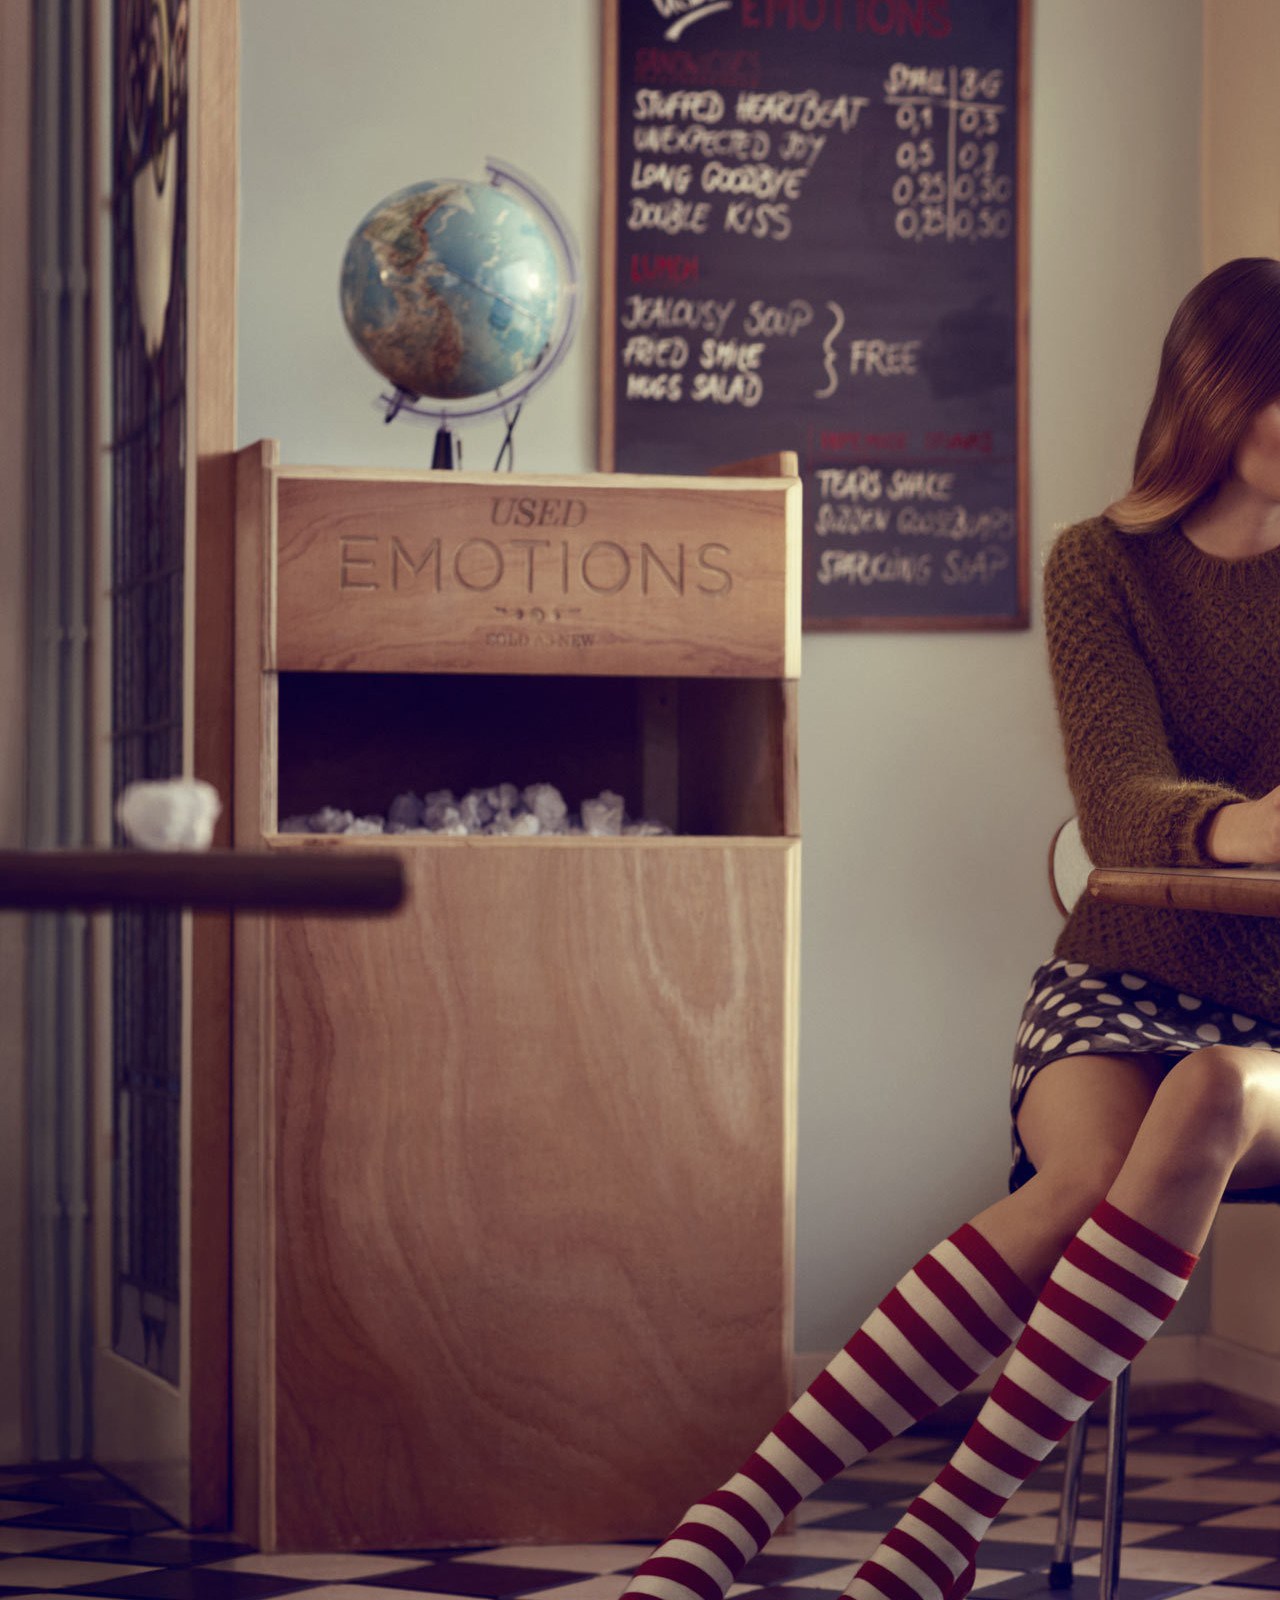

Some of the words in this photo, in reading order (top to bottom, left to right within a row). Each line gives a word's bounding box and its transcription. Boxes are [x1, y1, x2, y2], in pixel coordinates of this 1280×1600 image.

[633, 88, 725, 124] STUFFED
[736, 88, 870, 133] HEARTBEAT
[633, 124, 771, 160] UNEXPECTED
[631, 158, 692, 194] LONG
[701, 160, 811, 200] GOODBYE
[627, 197, 712, 235] DOUBLE
[724, 200, 792, 241] KISS
[621, 294, 736, 337] JEALOUSY
[624, 334, 689, 369] FRIED
[849, 339, 921, 377] FREE
[691, 371, 763, 407] SALAD
[490, 496, 588, 528] USED
[339, 535, 733, 597] EMOTIONS
